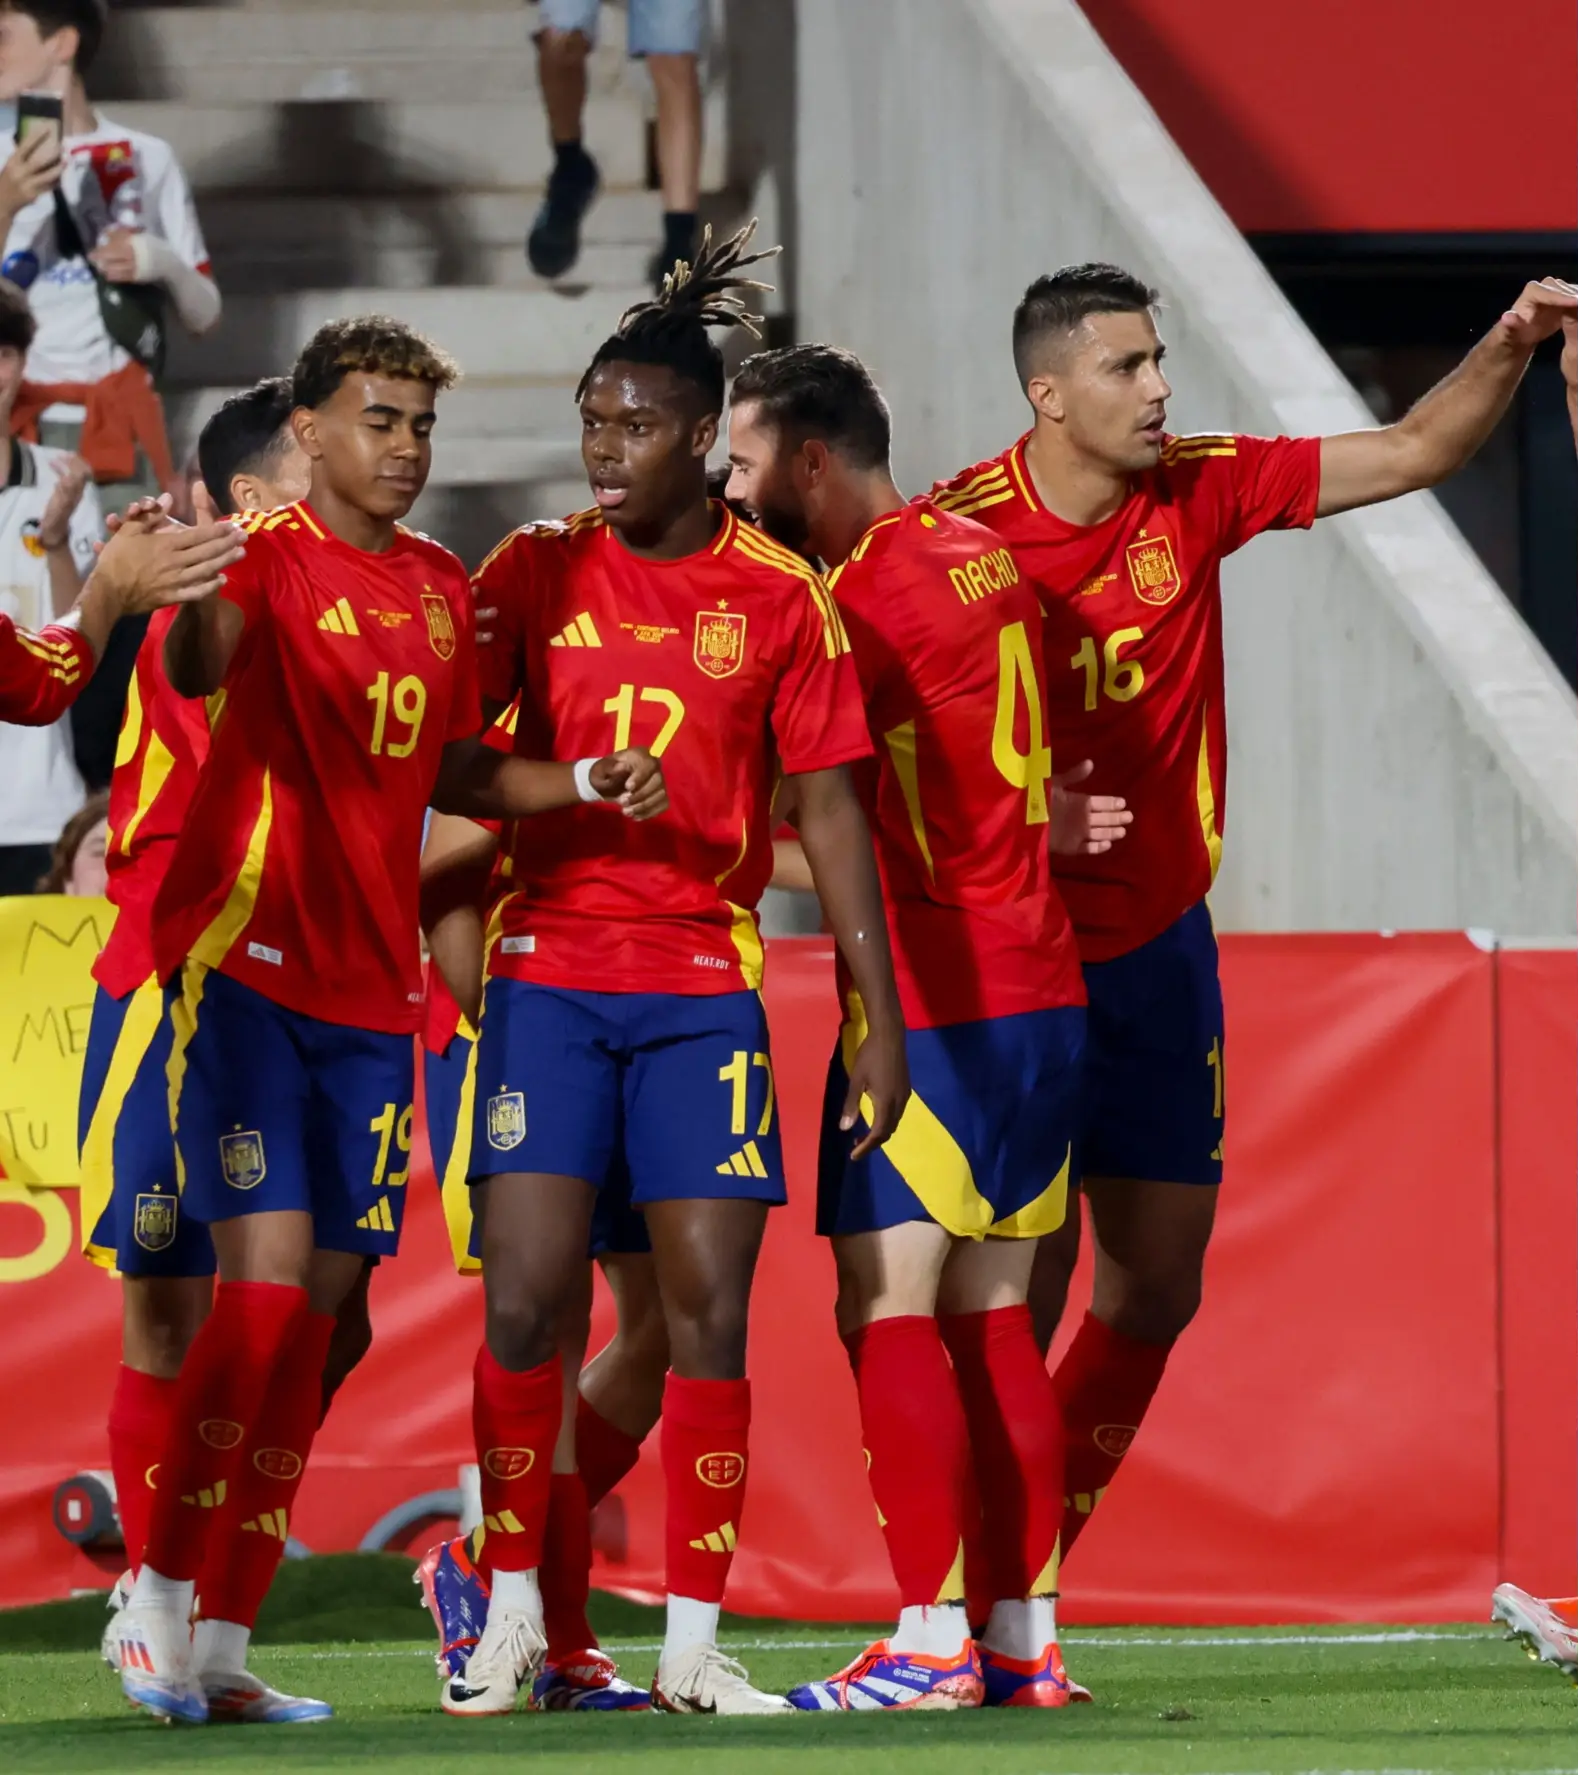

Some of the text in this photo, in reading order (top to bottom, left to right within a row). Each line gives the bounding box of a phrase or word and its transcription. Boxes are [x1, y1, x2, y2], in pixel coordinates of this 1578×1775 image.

[948, 548, 1019, 605] NACHO
[1070, 626, 1144, 711] 16
[367, 671, 427, 758] 19
[604, 684, 685, 758] 17
[992, 620, 1051, 825] 4
[719, 1051, 773, 1135] 17
[1207, 1036, 1221, 1118] 1
[370, 1103, 413, 1186] 19
